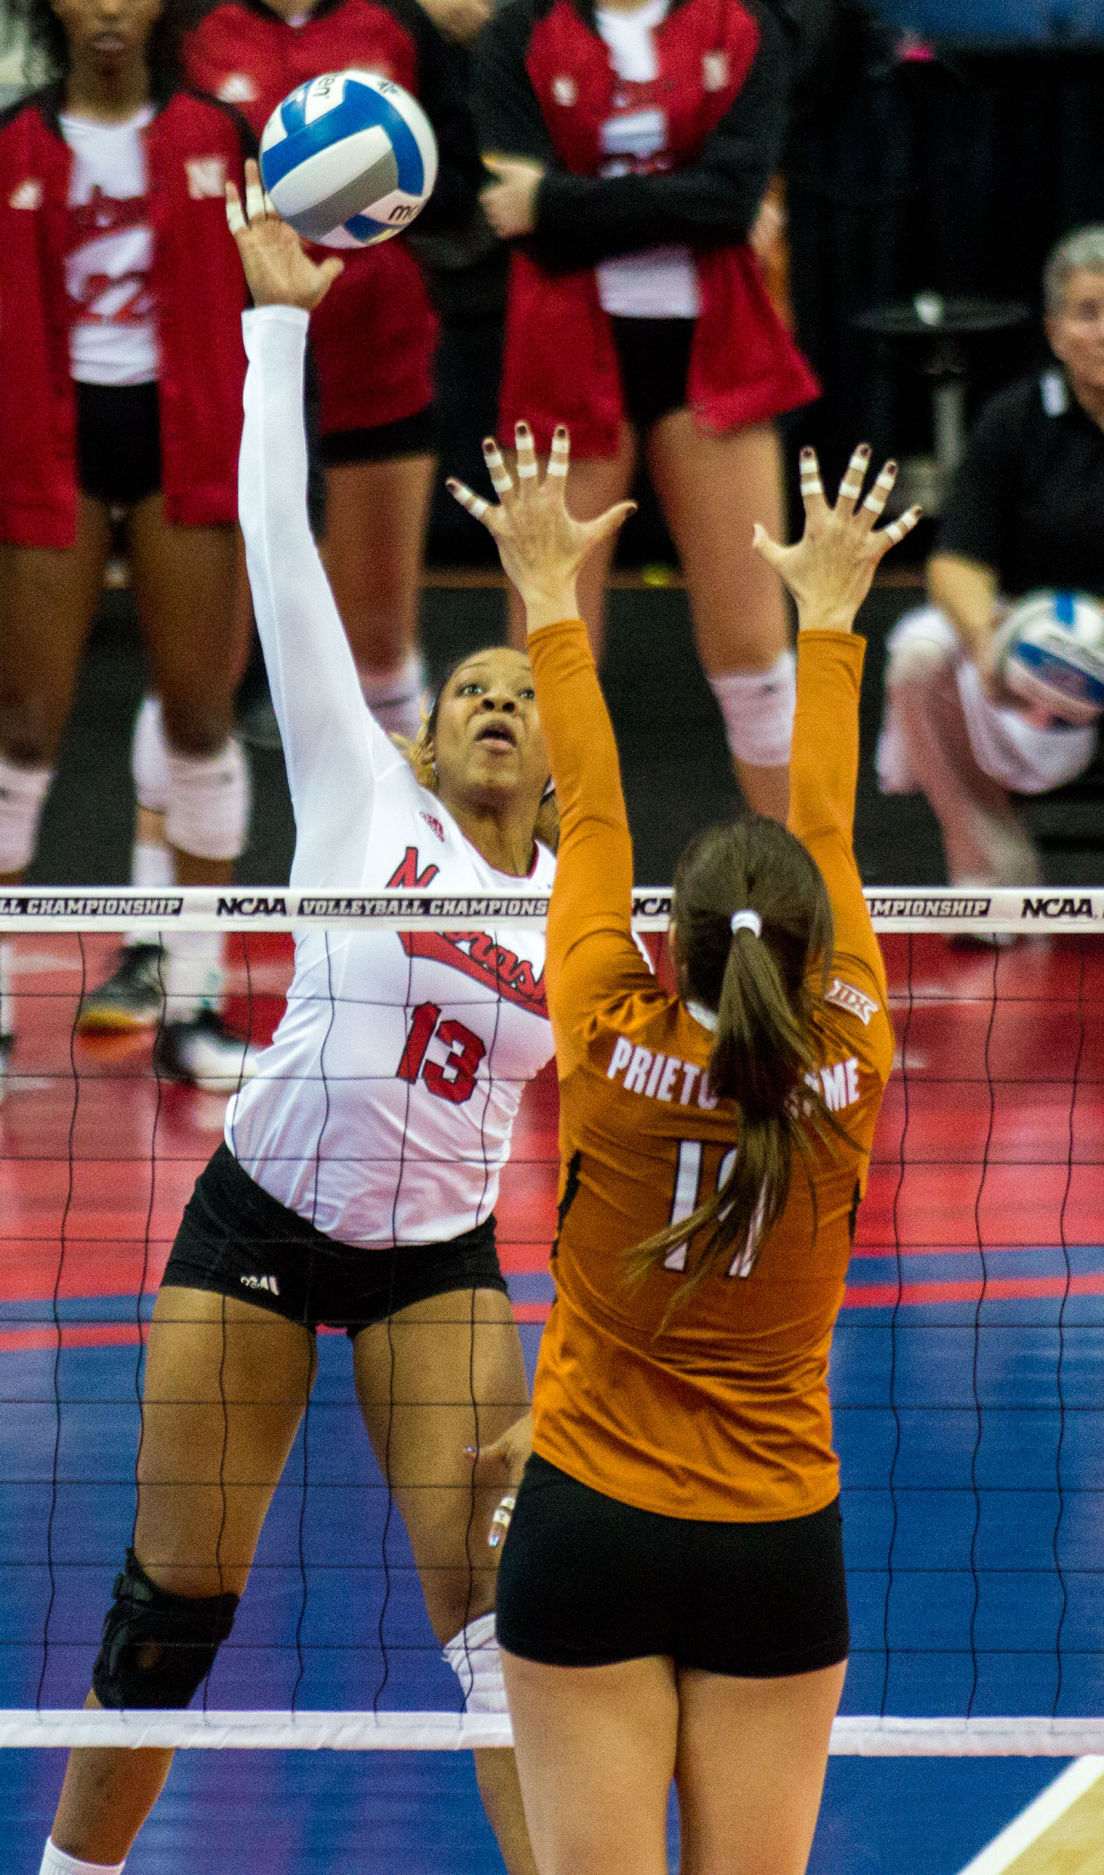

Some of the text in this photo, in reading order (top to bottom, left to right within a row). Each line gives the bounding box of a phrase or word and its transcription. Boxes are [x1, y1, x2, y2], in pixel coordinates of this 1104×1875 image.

[26, 899, 181, 915] CHAMPIONSHIP
[216, 898, 549, 917] NCAA VOLLEYBALL CHAMPIONS
[1021, 898, 1094, 918] NCAA
[396, 1001, 487, 1104] 13
